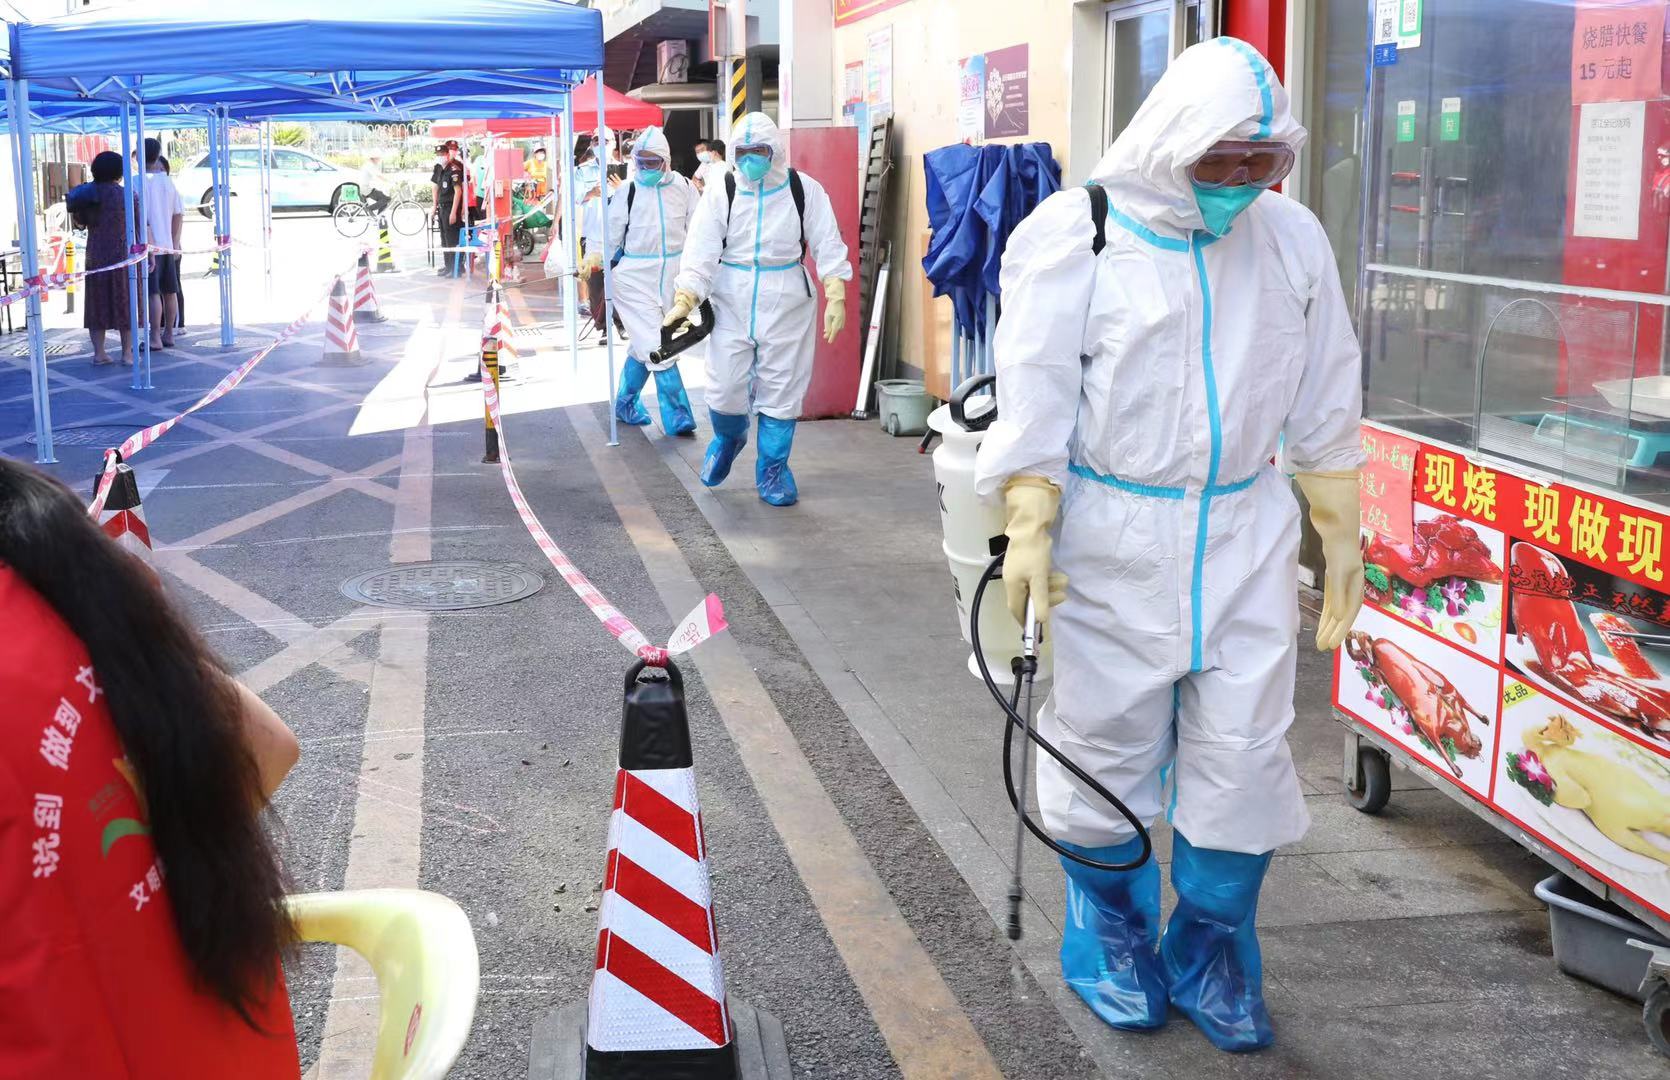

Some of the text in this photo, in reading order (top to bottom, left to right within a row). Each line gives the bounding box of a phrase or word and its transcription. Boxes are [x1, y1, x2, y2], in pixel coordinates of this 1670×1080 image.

[1582, 22, 1648, 49] 烧腊快餐
[1580, 56, 1632, 81] 15 元起
[1423, 453, 1664, 582] 现烧 现做现
[1503, 683, 1529, 704] 优品
[39, 697, 82, 771] 做到
[32, 793, 63, 878] 说到
